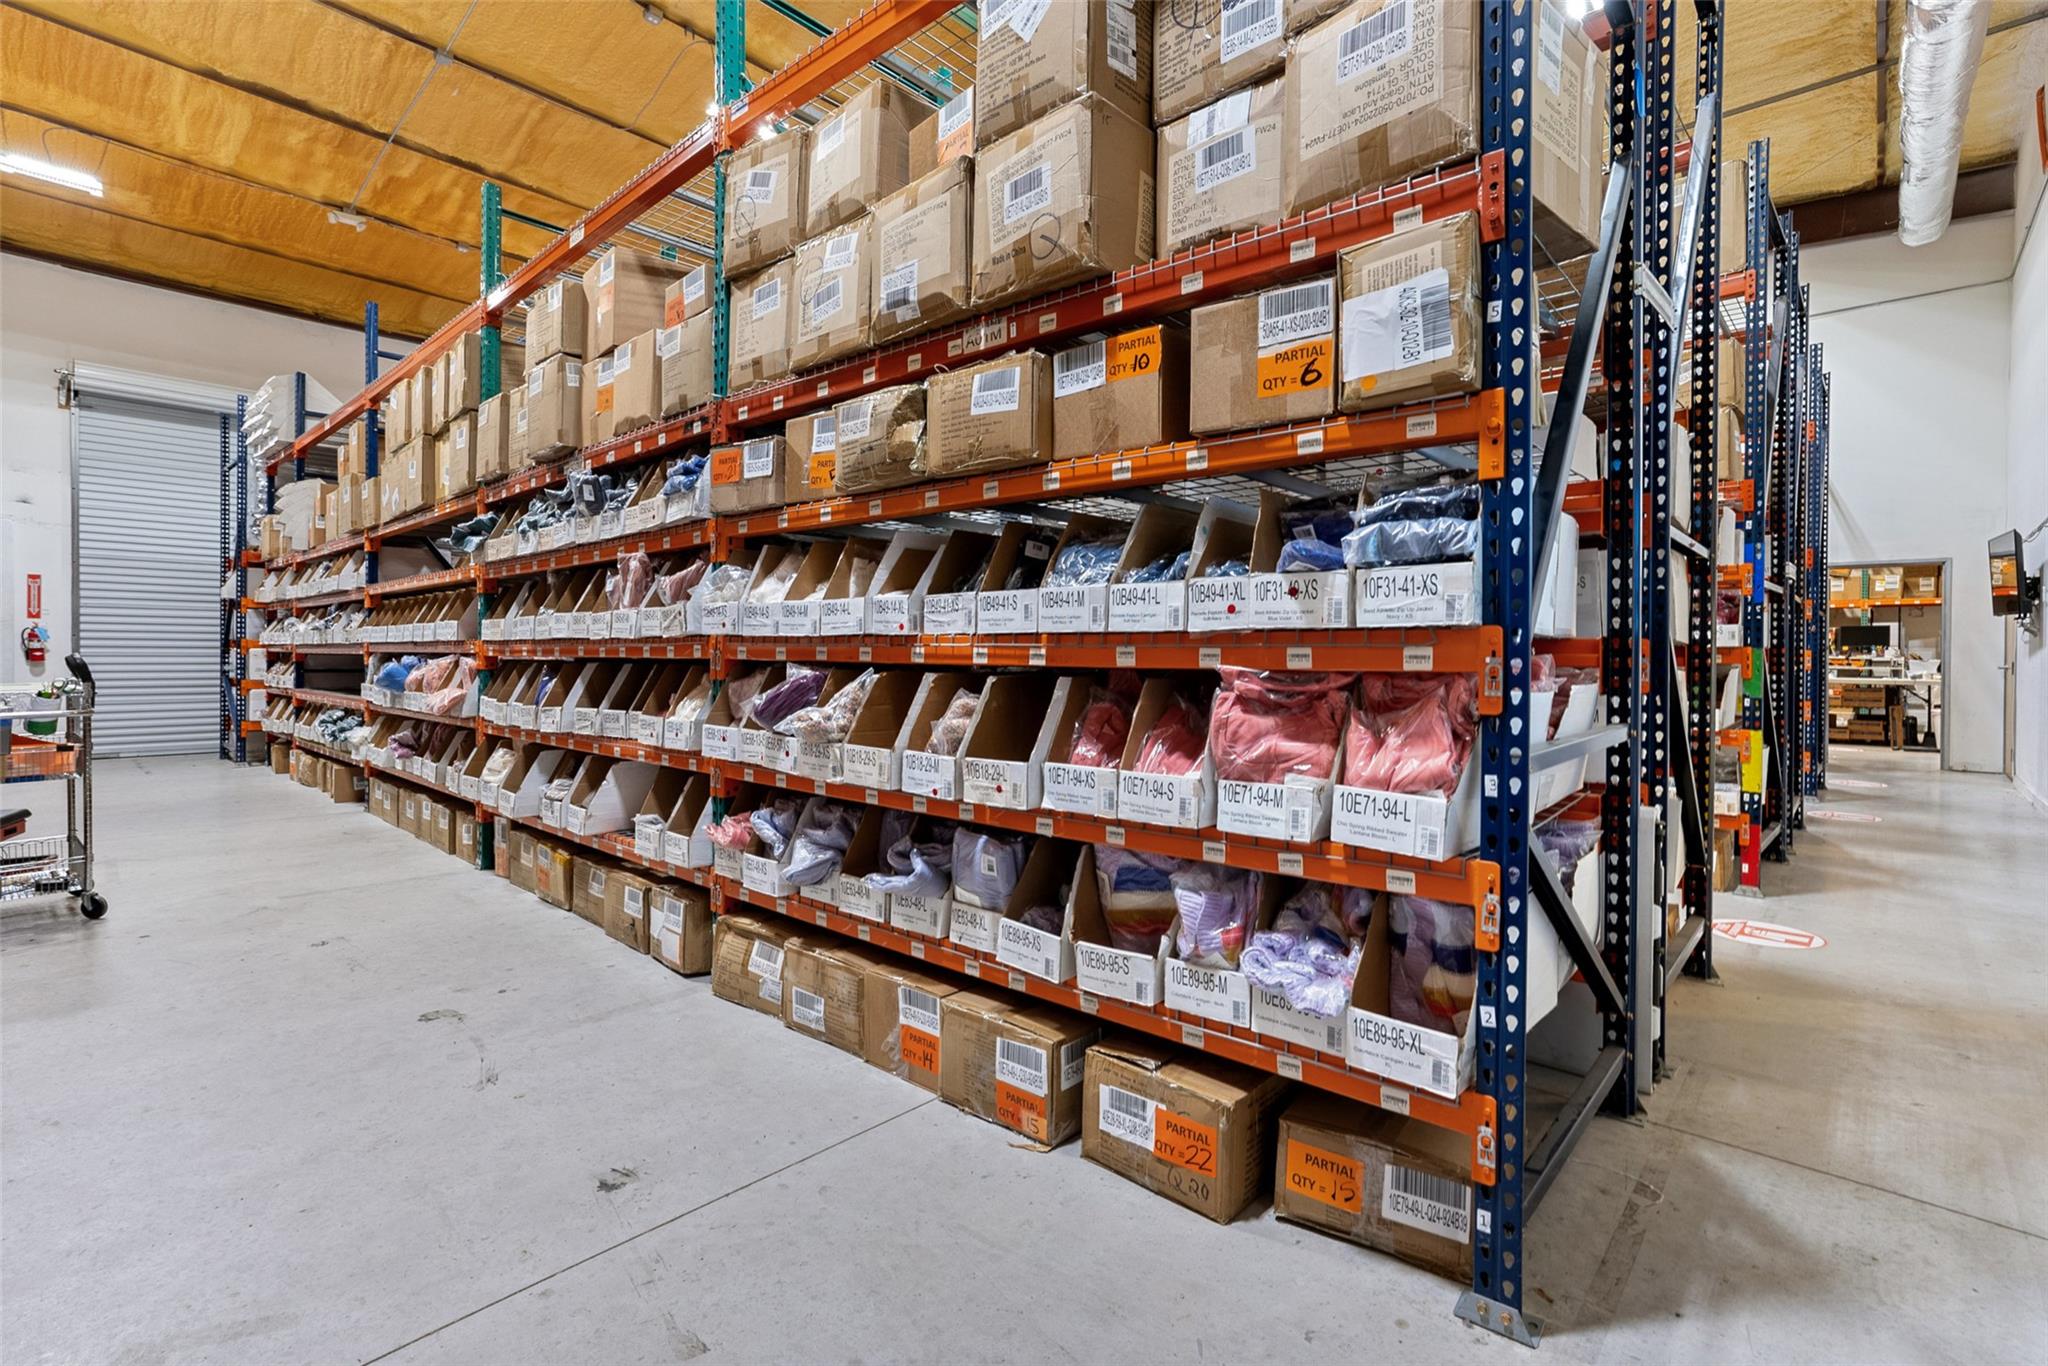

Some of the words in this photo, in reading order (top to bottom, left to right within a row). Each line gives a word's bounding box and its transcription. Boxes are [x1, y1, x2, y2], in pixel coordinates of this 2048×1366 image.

[1491, 305, 1499, 318] 5
[1119, 335, 1156, 352] PARTIAL
[1275, 345, 1326, 364] PARTIAL
[1109, 363, 1128, 377] QTY
[1263, 376, 1286, 391] QTY
[1300, 357, 1323, 388] 6
[811, 475, 823, 485] QTY
[1111, 587, 1160, 605] 10B49-41-L
[1191, 582, 1246, 604] 10B49-41-XL
[1363, 573, 1438, 599] 10F31-41-XS
[979, 594, 1018, 612] 10B49-41-S
[1041, 591, 1085, 608] 10B49-41-M
[966, 761, 1008, 784] 10B18-29-L
[1048, 767, 1096, 790] 10E71-94-XS
[1123, 776, 1174, 802] 10E71-94-S
[1223, 783, 1283, 809] 10E71-94-M
[1489, 778, 1497, 791] 3
[1339, 791, 1411, 823] 10E71-94-L
[1001, 923, 1042, 953] 10E89-95-XS
[1080, 950, 1130, 976] 10E89-95-S
[1172, 965, 1227, 996] 10E89-95-M
[1484, 1011, 1493, 1024] 2
[909, 1032, 936, 1052] PARTIAL
[1353, 1017, 1426, 1057] 10E89-95-XL
[903, 1047, 917, 1062] QTY
[1006, 1091, 1041, 1114] PARTIAL
[999, 1107, 1015, 1124] QTY
[1026, 1116, 1040, 1136] 15
[1167, 1120, 1211, 1146] PARTIAL
[1155, 1140, 1175, 1157] QTY
[1185, 1145, 1213, 1172] 22
[1305, 1153, 1356, 1180] PARTIAL
[1292, 1173, 1316, 1190] QTY
[1479, 1214, 1488, 1227] 1
